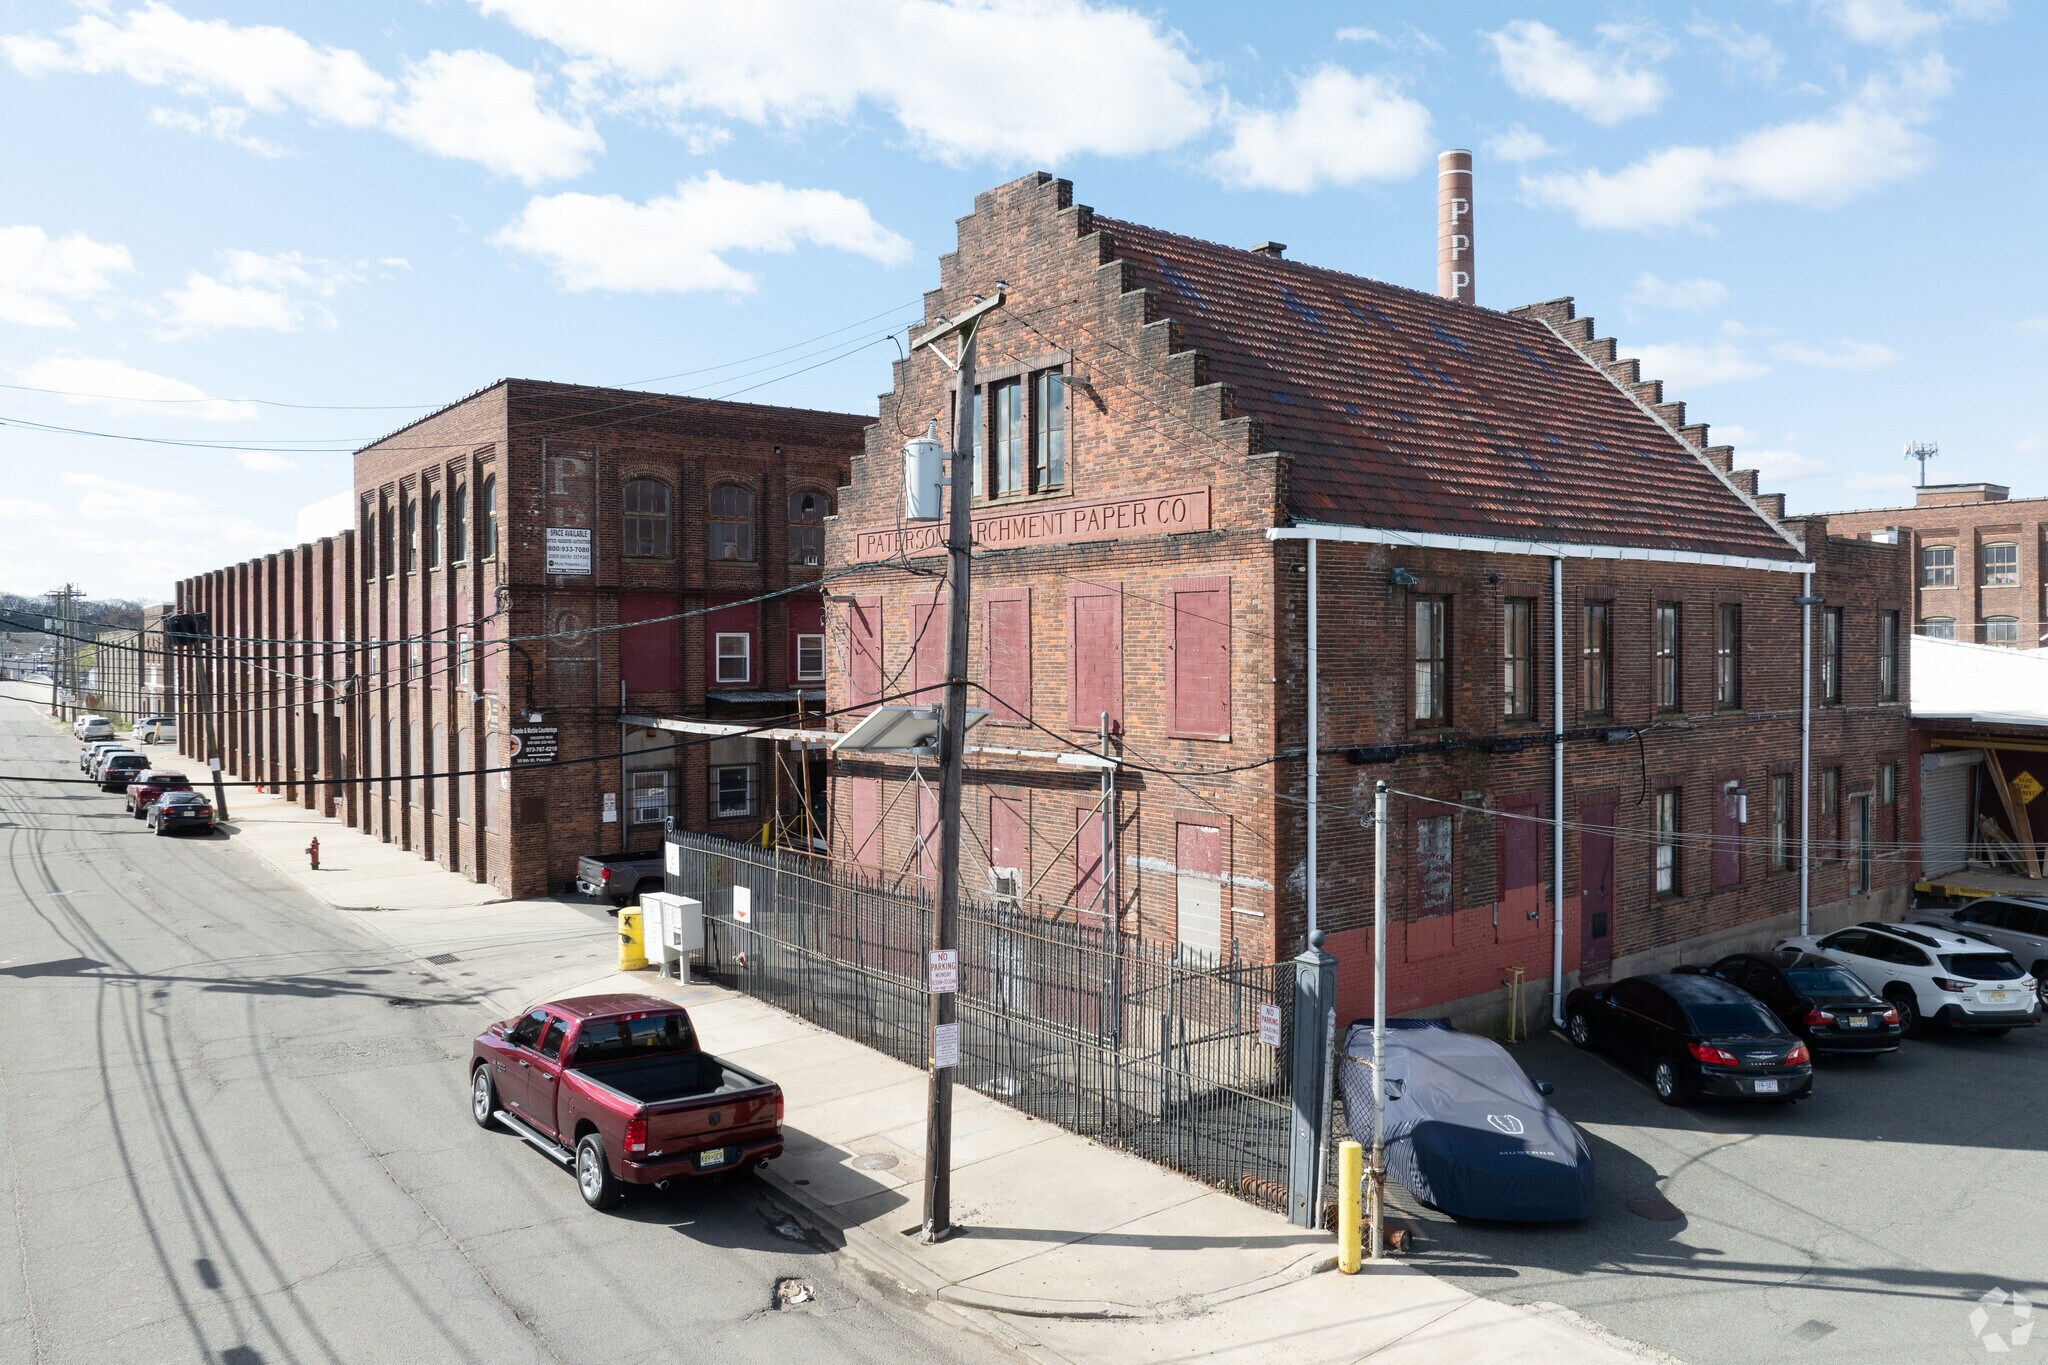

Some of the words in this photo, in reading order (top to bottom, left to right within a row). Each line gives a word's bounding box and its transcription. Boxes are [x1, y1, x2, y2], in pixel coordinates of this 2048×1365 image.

[866, 525, 948, 555] PATERSON
[1074, 504, 1147, 533] PAPER
[1157, 497, 1187, 524] CO
[938, 953, 948, 961] NO
[930, 962, 956, 971] PARKING
[1266, 1008, 1274, 1016] NO
[1261, 1015, 1279, 1026] PARKING
[1261, 1026, 1279, 1034] LOADING
[1264, 1033, 1275, 1041] ZONE
